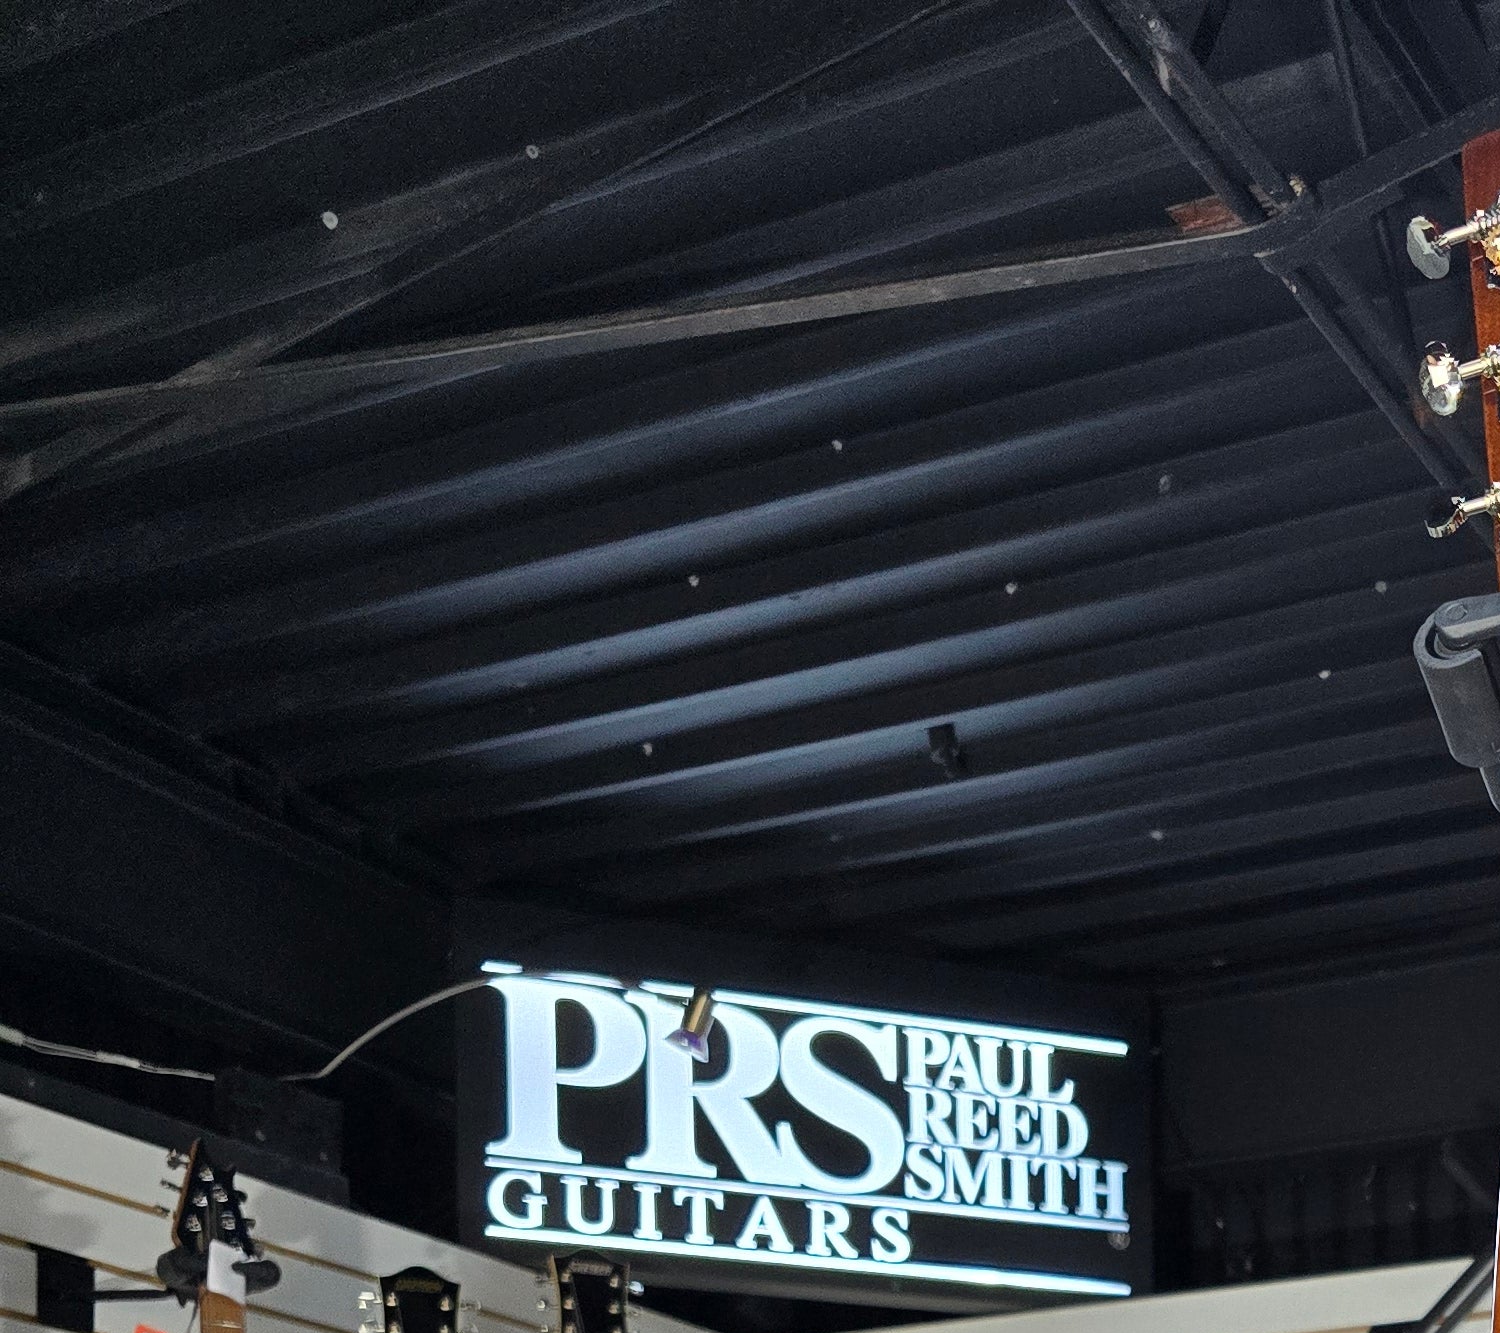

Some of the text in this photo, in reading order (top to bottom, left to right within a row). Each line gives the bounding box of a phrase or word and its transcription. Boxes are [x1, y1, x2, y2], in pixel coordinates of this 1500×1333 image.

[486, 976, 904, 1195] PRS
[903, 1027, 1075, 1104] PAUL
[906, 1084, 1090, 1160] REED
[486, 1169, 913, 1263] GUITARS
[904, 1144, 1130, 1221] SMITH
